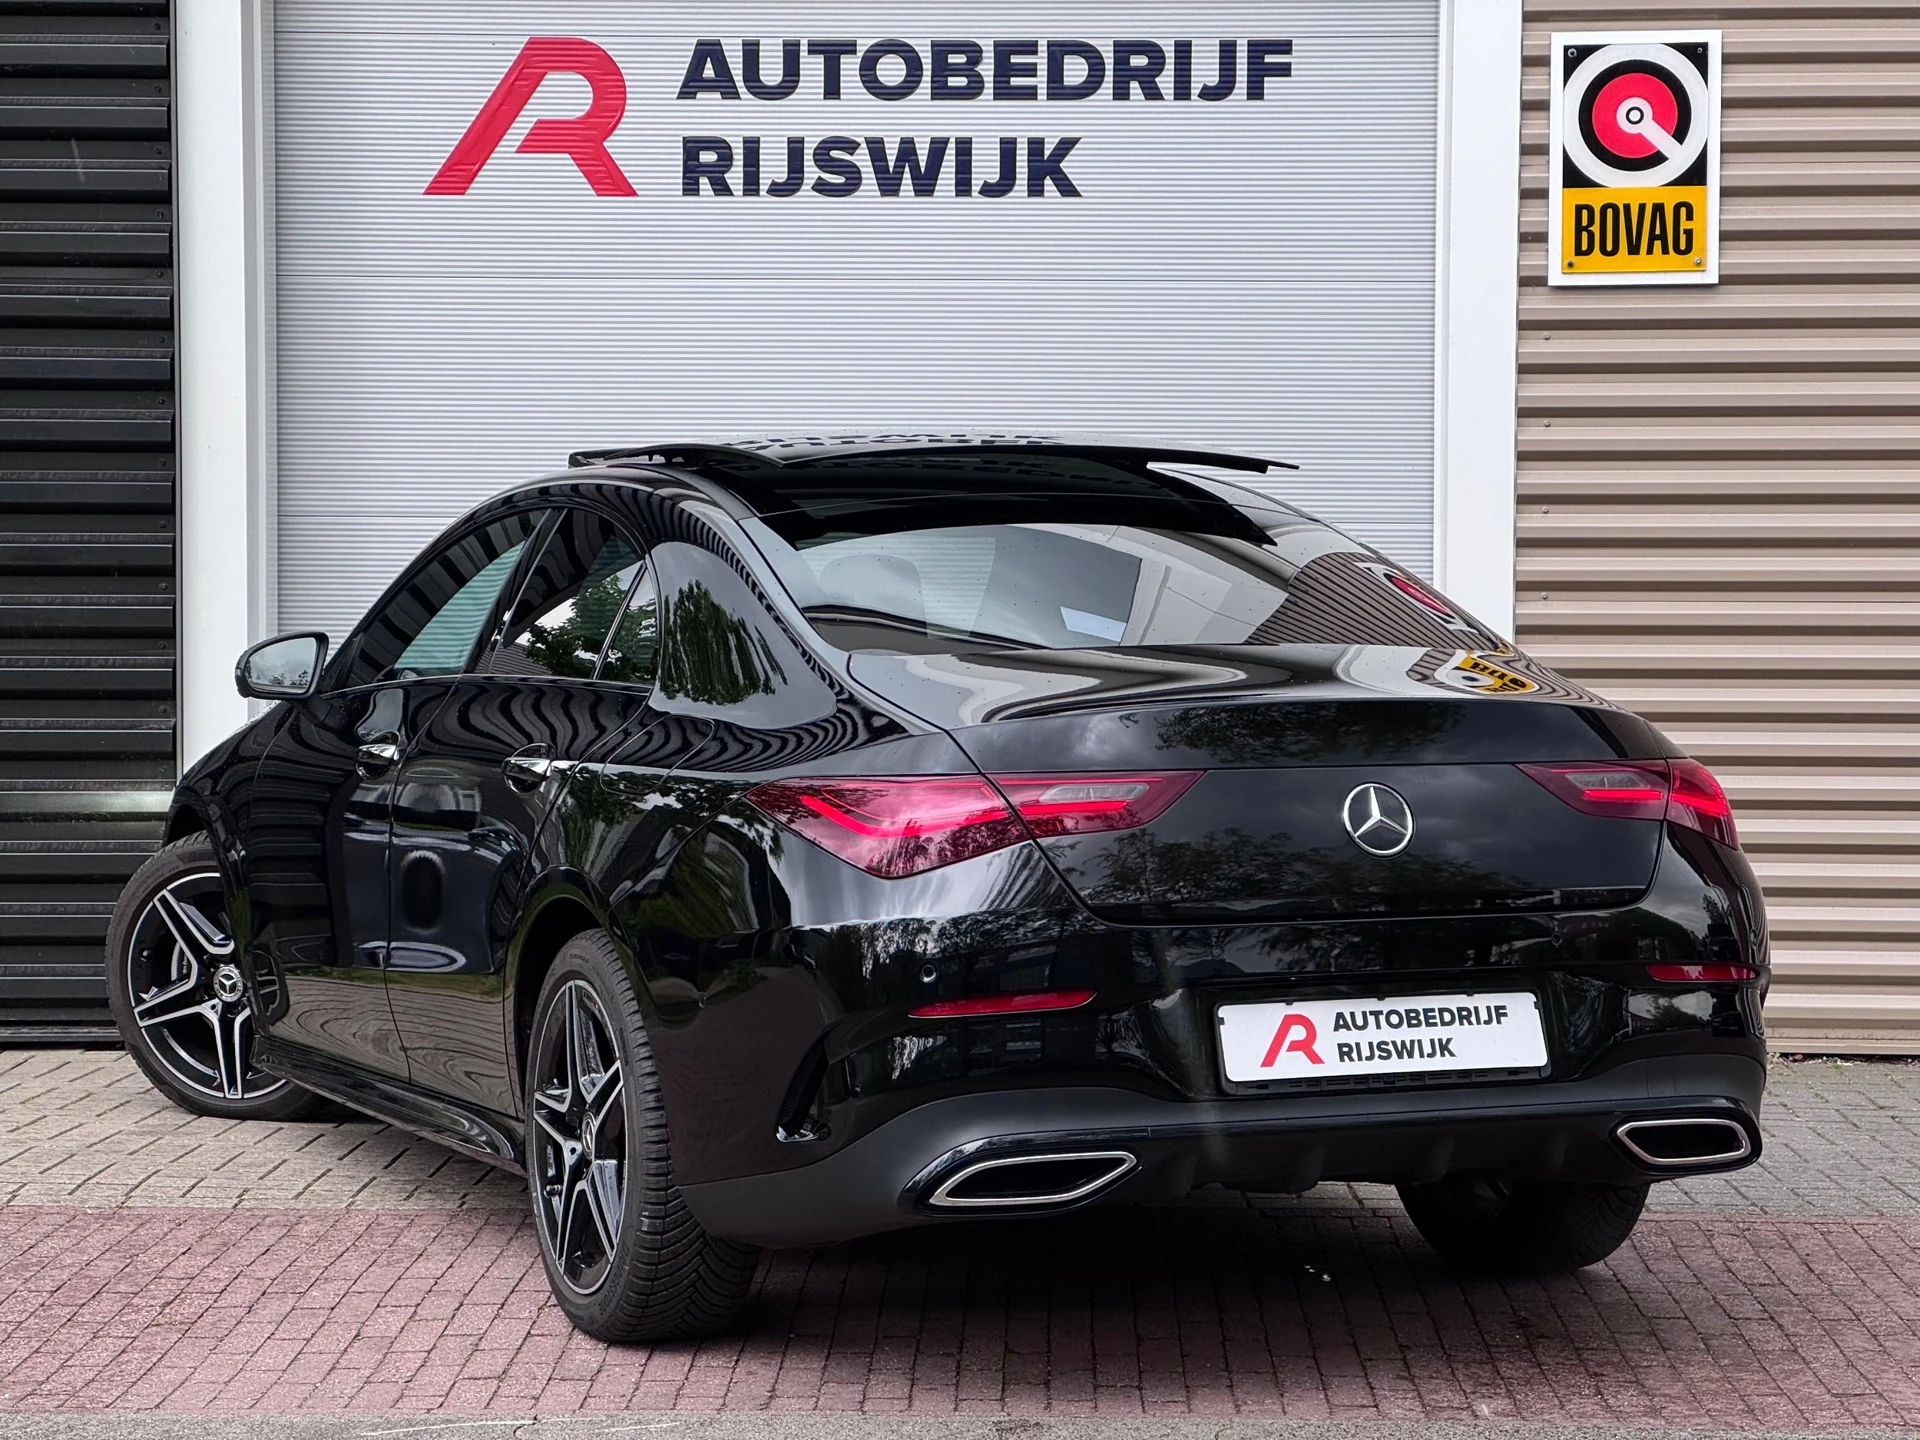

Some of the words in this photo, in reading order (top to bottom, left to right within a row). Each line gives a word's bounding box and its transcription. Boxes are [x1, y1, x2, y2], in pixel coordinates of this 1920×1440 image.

[677, 39, 1294, 102] AUTOBEDRIJF
[683, 136, 1084, 199] RIJSWIJK
[1574, 201, 1695, 257] BOVAG
[1333, 1005, 1509, 1032] AUTOBEDRIJF
[1337, 1037, 1457, 1063] RIJSWIJK
